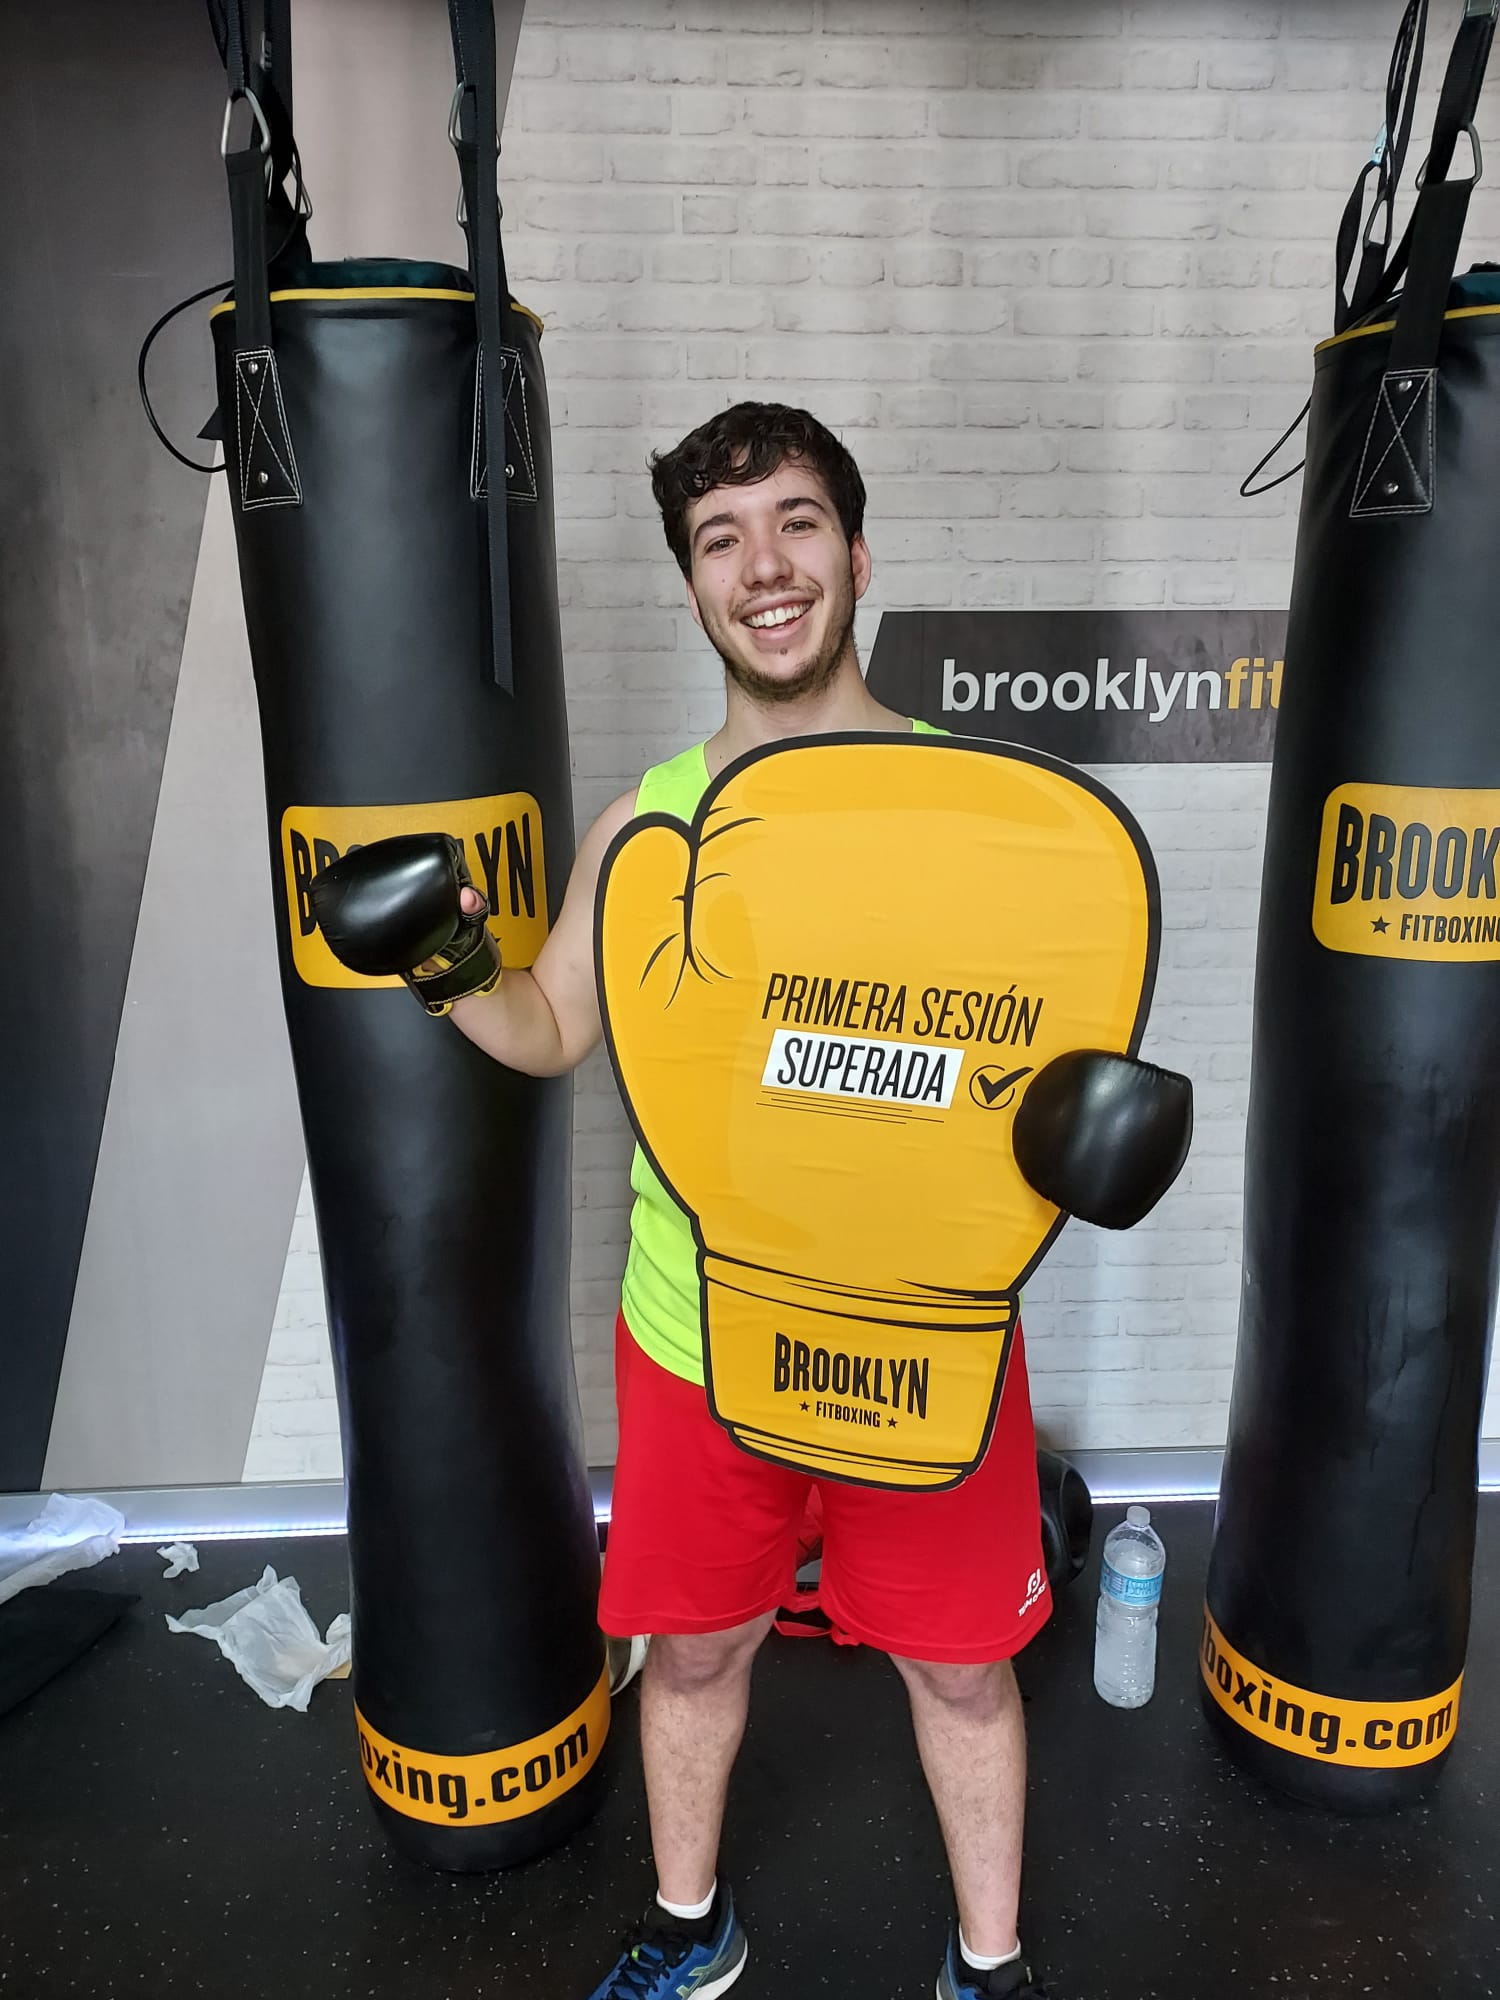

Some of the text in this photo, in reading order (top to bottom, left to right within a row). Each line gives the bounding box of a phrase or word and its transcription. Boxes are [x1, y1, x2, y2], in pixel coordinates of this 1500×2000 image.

[761, 972, 1044, 1047] PRIMERA SESIÓN
[777, 1037, 948, 1103] SUPERADA
[773, 1331, 930, 1420] BROOKLYN
[815, 1400, 881, 1429] FITBOXING
[1202, 1615, 1453, 1755] boxing.com
[360, 1722, 589, 1819] oxing.com
